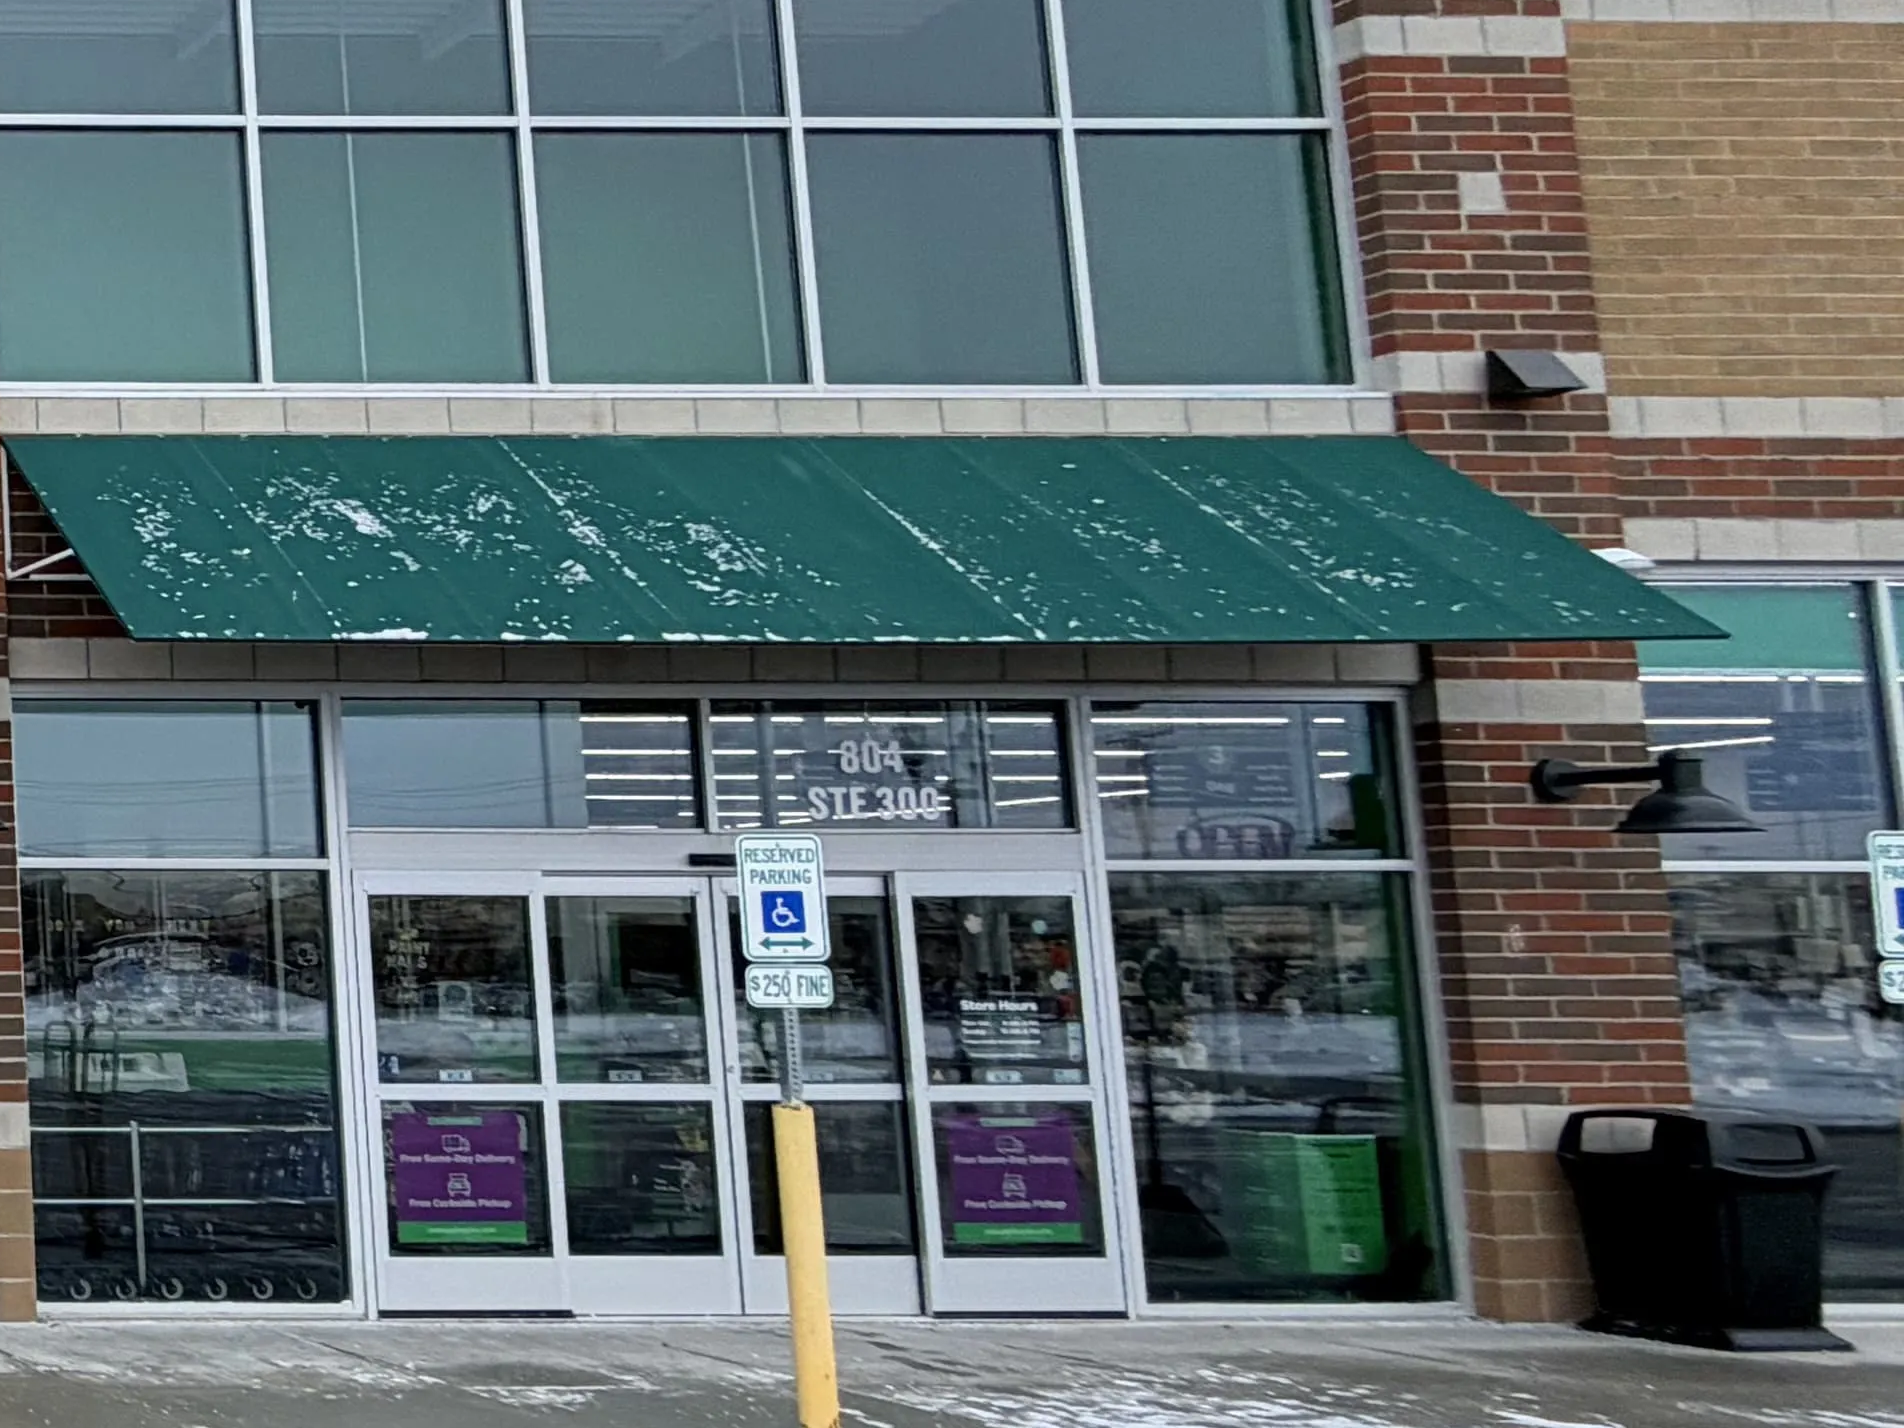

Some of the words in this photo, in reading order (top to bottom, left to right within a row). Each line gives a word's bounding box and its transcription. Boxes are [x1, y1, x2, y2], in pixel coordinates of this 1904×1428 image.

[840, 739, 904, 774] 804
[808, 786, 867, 820] STE
[875, 786, 941, 820] 300
[744, 848, 815, 863] RESERVED
[750, 869, 812, 884] PARKING
[797, 975, 829, 997] FINE
[960, 1000, 996, 1011] Store
[999, 1000, 1038, 1011] Hours
